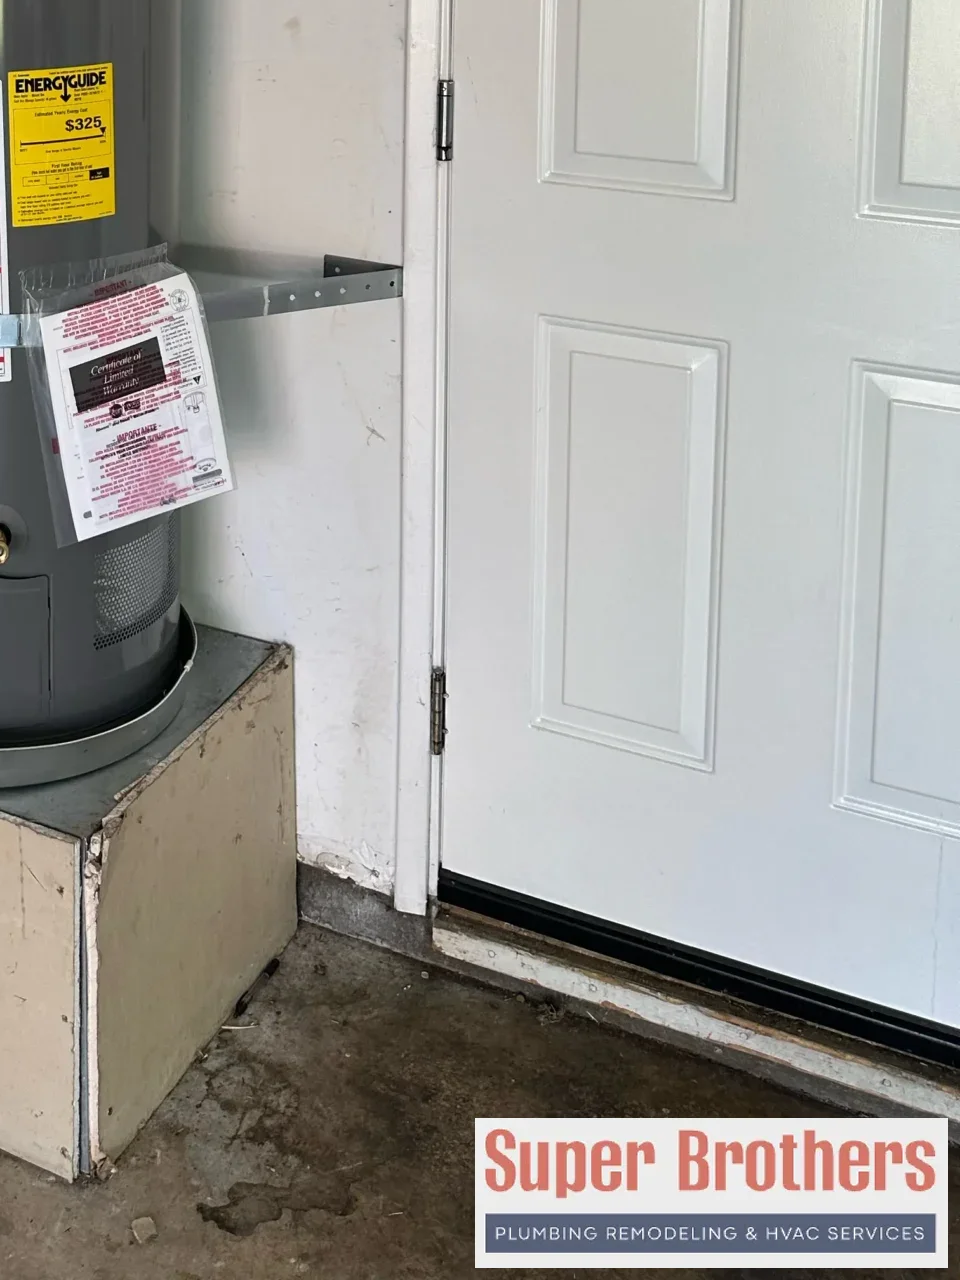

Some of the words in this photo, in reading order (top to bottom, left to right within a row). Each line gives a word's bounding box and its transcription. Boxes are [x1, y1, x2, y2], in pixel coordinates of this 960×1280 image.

[16, 71, 106, 94] ENERGYGUIDE
[65, 116, 102, 132] $325
[90, 354, 131, 376] Certificate
[104, 364, 134, 384] Limited
[116, 424, 158, 441] IMPORTANTE
